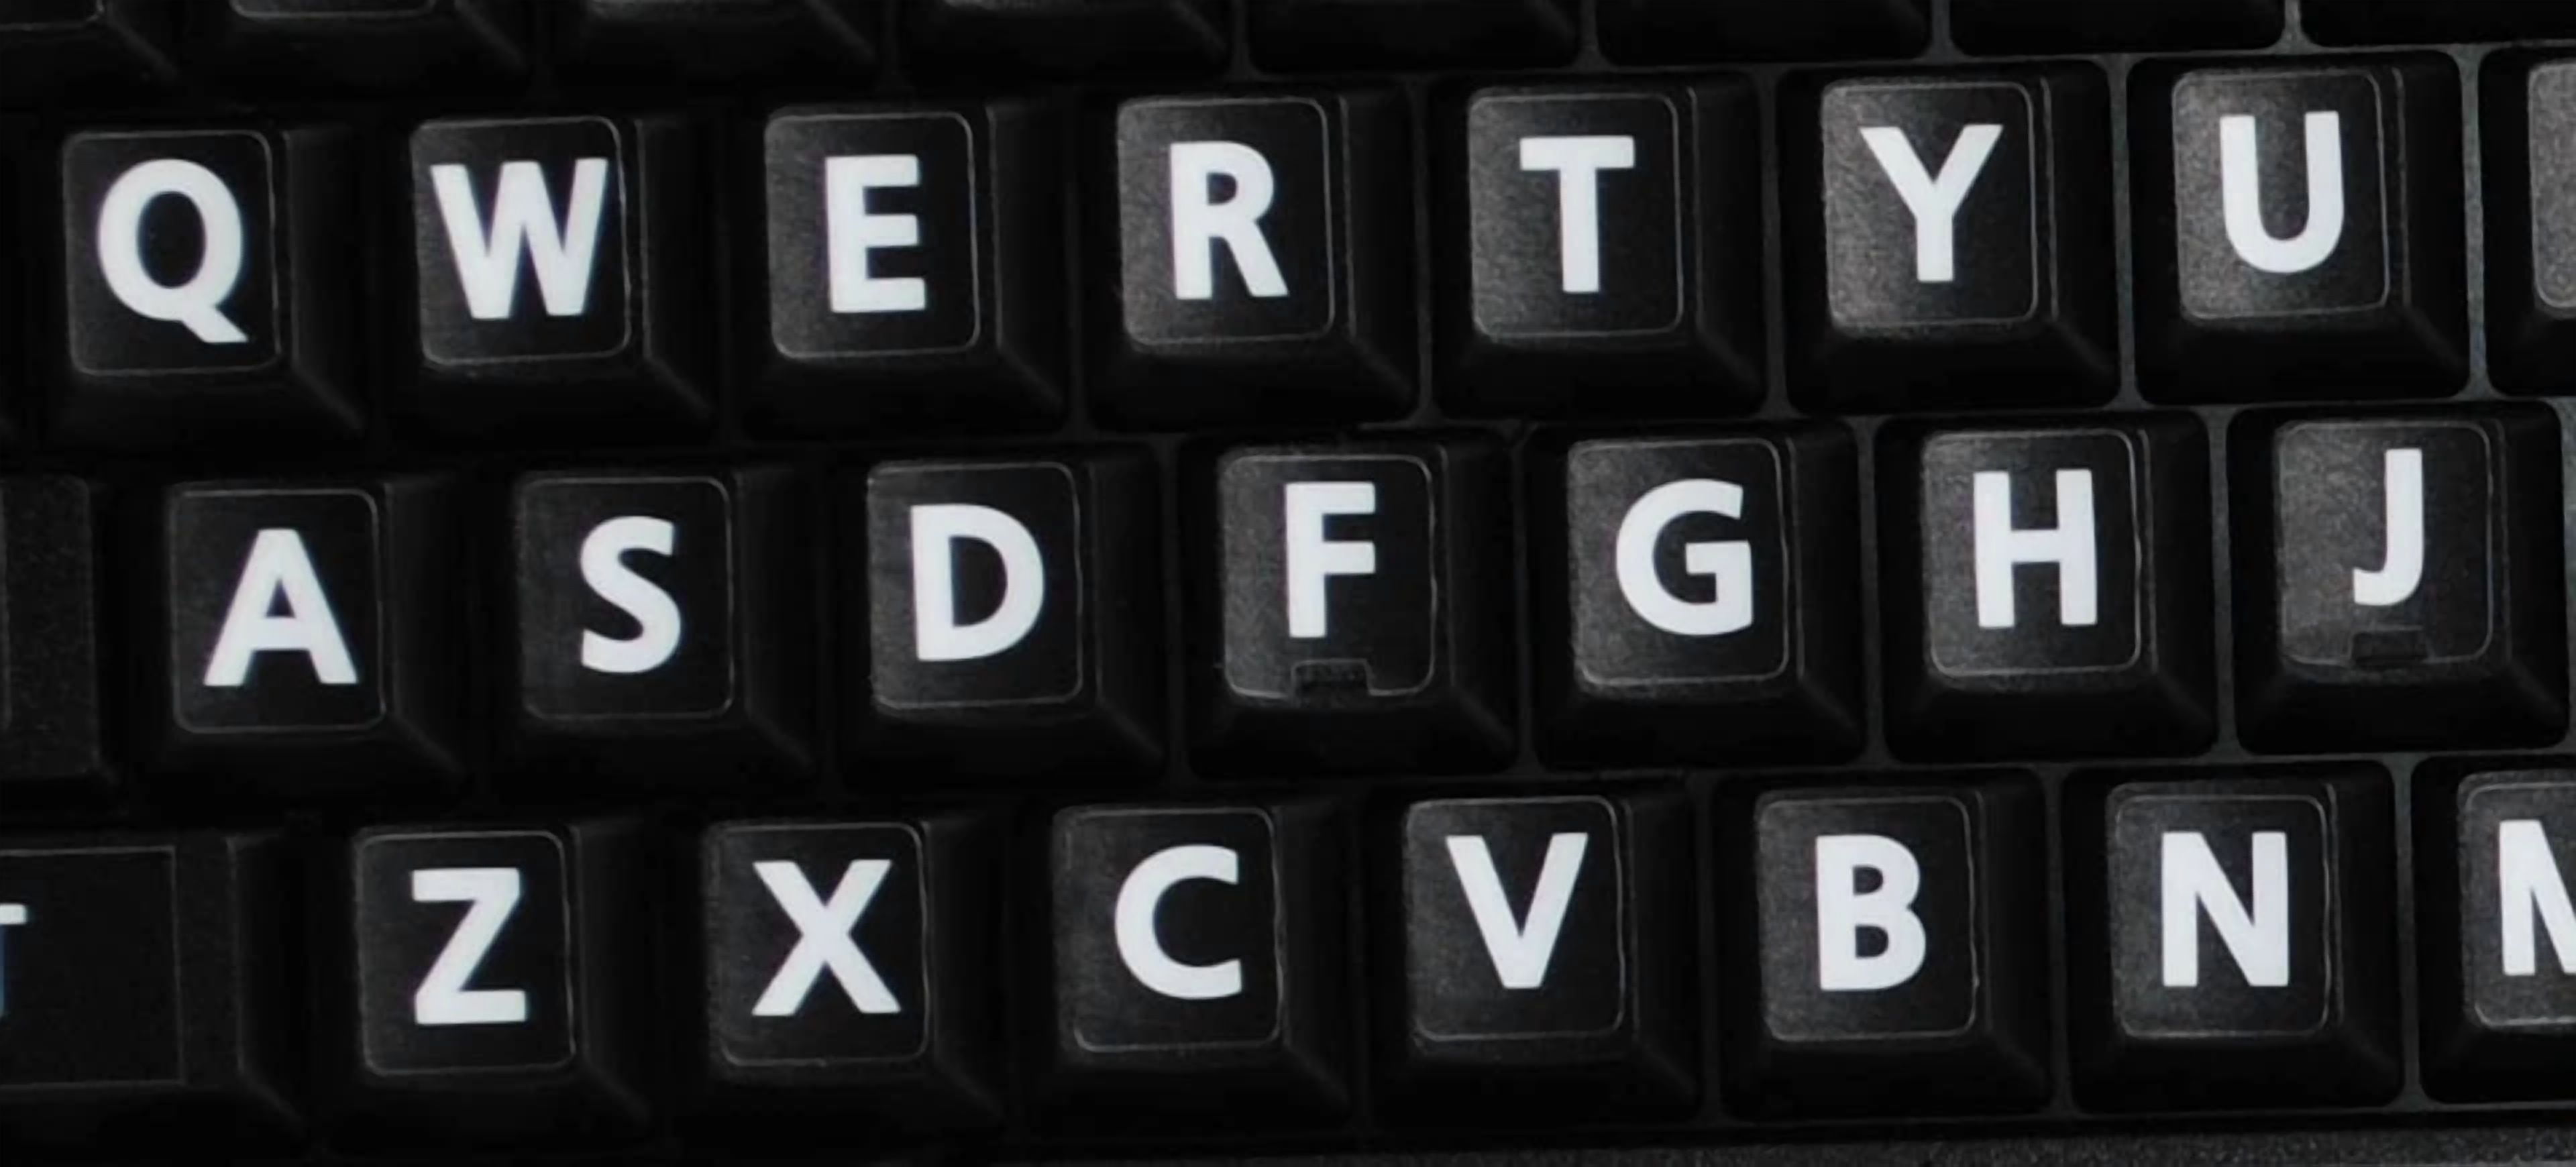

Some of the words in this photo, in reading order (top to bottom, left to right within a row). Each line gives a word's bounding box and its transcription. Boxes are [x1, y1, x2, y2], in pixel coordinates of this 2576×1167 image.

[97, 159, 246, 343] Q
[430, 158, 607, 319] W
[824, 155, 926, 313] E
[1169, 141, 1287, 300] R
[1519, 135, 1635, 293] T
[1858, 124, 2002, 282] Y
[2218, 111, 2344, 274] U
[580, 516, 681, 673] S
[910, 504, 1044, 661] D
[1285, 482, 1375, 638] F
[1615, 479, 1752, 636] G
[1972, 469, 2097, 629] H
[2352, 448, 2424, 606] J
[204, 529, 357, 686] A
[412, 867, 526, 1025] Z
[752, 859, 900, 1016] X
[1114, 845, 1242, 999] C
[1446, 832, 1588, 989] V
[1815, 834, 1926, 991] B
[2161, 831, 2289, 987] N
